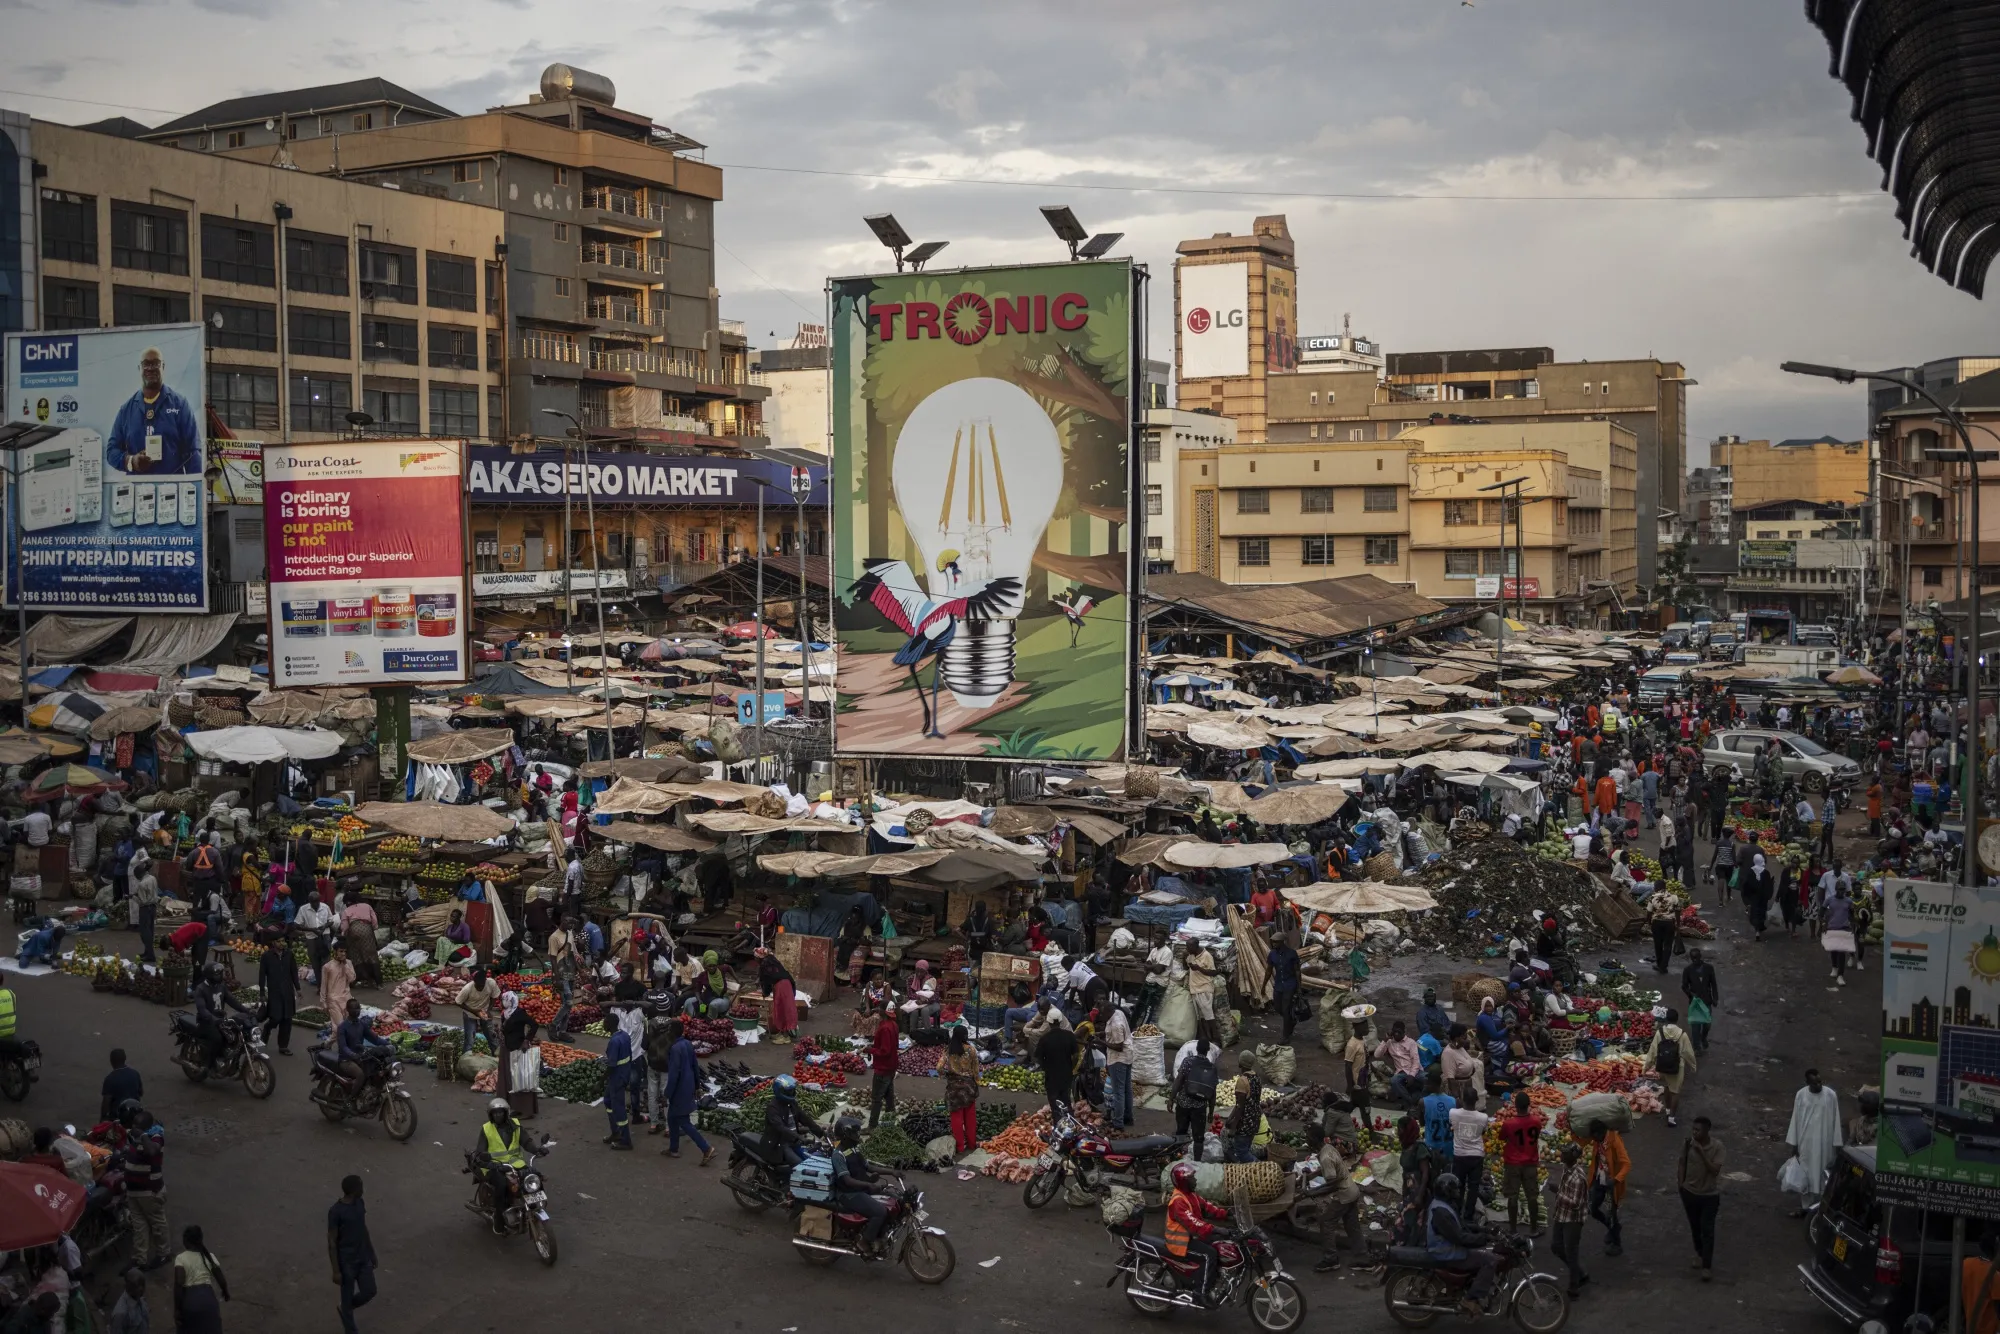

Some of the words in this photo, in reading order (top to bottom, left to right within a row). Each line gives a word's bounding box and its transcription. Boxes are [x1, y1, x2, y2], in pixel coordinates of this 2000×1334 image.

[869, 292, 1088, 345] TRONIC
[1215, 309, 1243, 328] LG
[803, 323, 816, 333] BANK
[818, 326, 824, 334] OF
[801, 332, 826, 345] BARODA
[57, 402, 78, 412] ISO
[468, 460, 622, 495] AKASERO
[626, 466, 738, 496] MARKET
[280, 490, 350, 504] Ordinary
[281, 505, 294, 517] is
[298, 504, 350, 518] boring
[283, 523, 309, 533] our
[313, 520, 354, 534] paint
[55, 537, 76, 545] YOUR
[78, 536, 107, 545] POWER
[109, 536, 128, 545] BILLS
[129, 536, 166, 545] SMARTLY
[169, 536, 194, 546] WITH
[283, 535, 296, 547] is
[300, 534, 326, 546] not
[22, 550, 64, 566] CHINT
[67, 550, 129, 566] PREPAID
[132, 551, 196, 567] METERS
[284, 553, 344, 564] Introducing
[347, 553, 366, 562] Our
[369, 552, 414, 563] Superior
[285, 567, 326, 576] Product
[329, 566, 362, 576] Range
[62, 574, 140, 584] www.chintuganda.com
[482, 575, 512, 584] NAKASERO
[514, 574, 537, 583] MARKET
[42, 592, 59, 602] 393
[61, 592, 76, 602] 130
[99, 594, 111, 602] or
[137, 592, 156, 602] 393
[158, 592, 175, 603] 130
[177, 593, 197, 603] 666
[333, 608, 352, 619] vinyl
[354, 608, 367, 617] silk
[373, 605, 415, 615] supergloss
[1514, 1126, 1539, 1146] 19
[1874, 1173, 1934, 1189] GUJARAT
[49, 1189, 67, 1209] airtel
